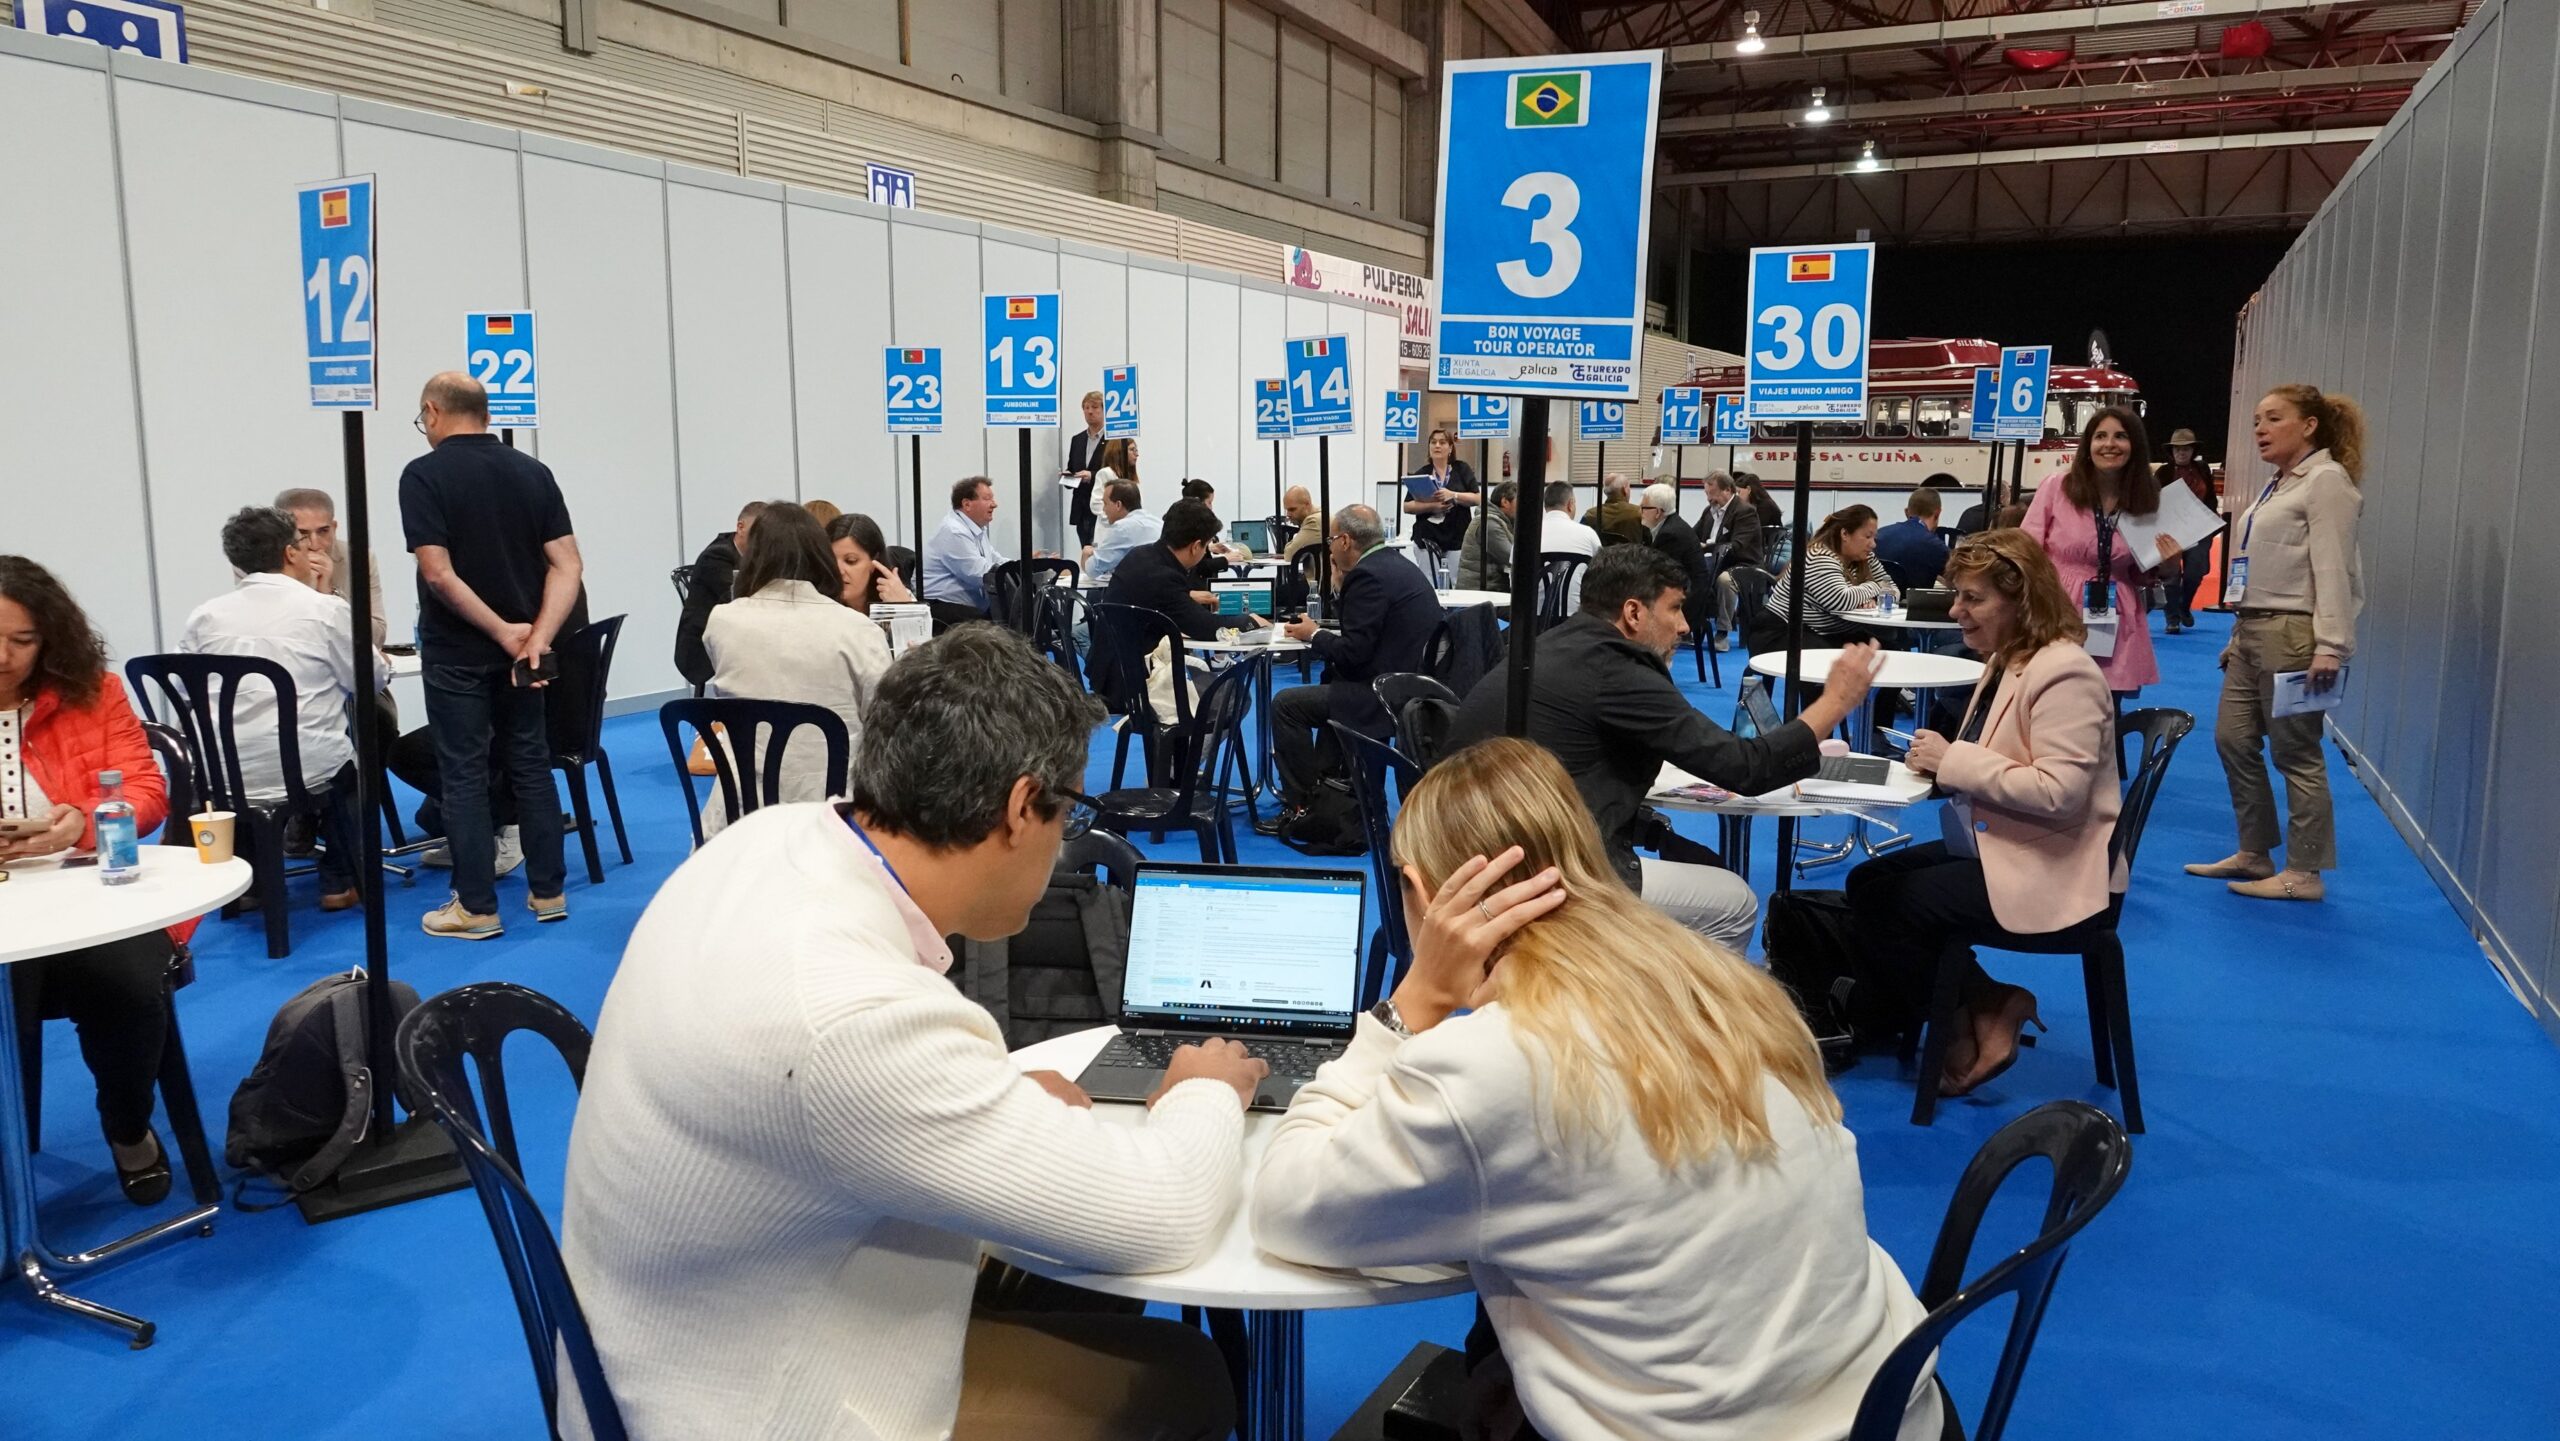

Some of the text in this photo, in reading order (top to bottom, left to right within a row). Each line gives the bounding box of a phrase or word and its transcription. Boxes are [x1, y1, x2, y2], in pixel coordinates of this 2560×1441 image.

[1496, 171, 1582, 298] 3
[1363, 265, 1424, 300] PULPERIA
[308, 255, 370, 343] 12
[1488, 326, 1581, 341] BON VOYAGE
[1755, 303, 1861, 371] 30
[1412, 344, 1423, 358] 609
[1474, 340, 1596, 357] TOUR OPERATOR
[471, 349, 534, 394] 22
[990, 336, 1056, 388] 13
[1452, 368, 1496, 377] DE GALICIA
[1453, 359, 1480, 368] XUNTA
[1508, 363, 1557, 380] galicia
[1587, 365, 1631, 374] TUREXPO
[1293, 366, 1349, 408] 14
[1586, 374, 1623, 383] GALICIA
[888, 374, 941, 409] 23
[1758, 386, 1854, 395] VIAJES MUNDO AMIGO
[2012, 376, 2034, 413] 6
[1106, 388, 1137, 418] 24
[1258, 399, 1290, 423] 25
[1462, 394, 1509, 415] 15
[1583, 401, 1623, 422] 16
[1386, 407, 1417, 428] 26
[1665, 405, 1698, 428] 17
[1719, 410, 1749, 430] 18
[1858, 449, 1922, 463] CUIÑA
